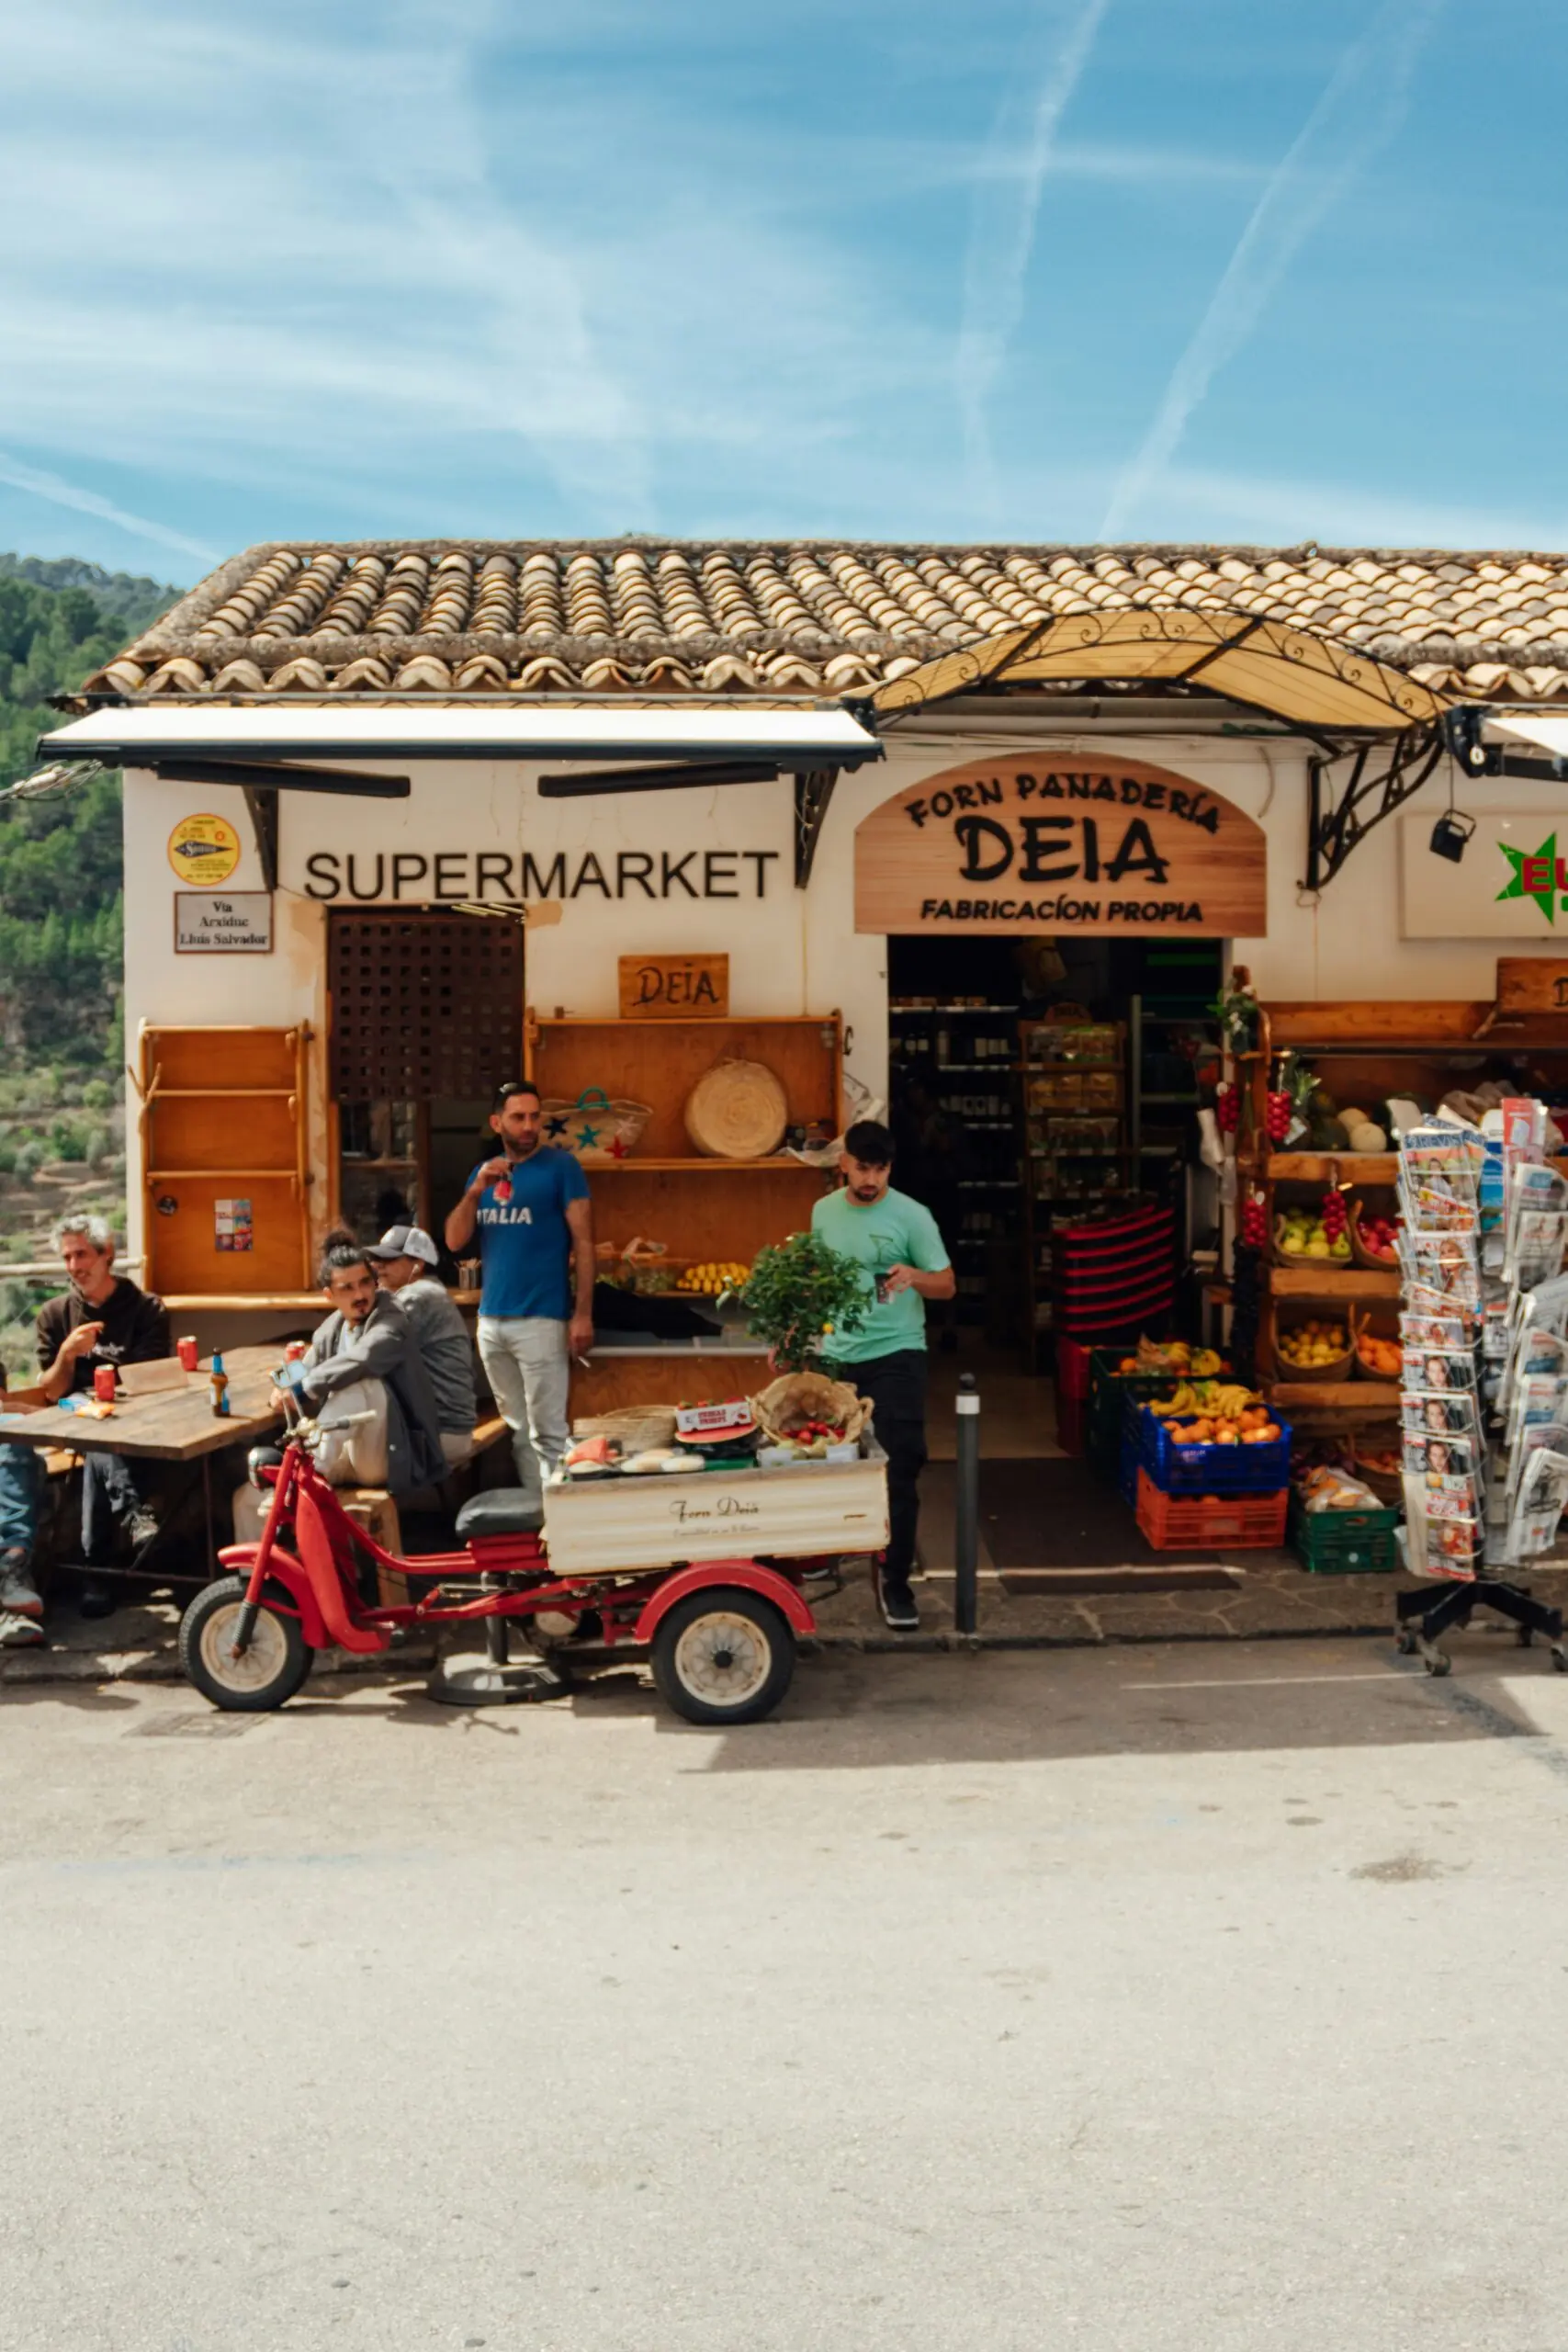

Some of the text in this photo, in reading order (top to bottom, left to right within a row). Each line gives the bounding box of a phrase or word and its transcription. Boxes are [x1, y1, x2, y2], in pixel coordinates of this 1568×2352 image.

[905, 773, 1221, 834] FORN PANADERÍA
[953, 814, 1170, 884] DEIA
[304, 852, 779, 899] SUPERMARKET
[199, 915, 249, 927] Arxiduc
[920, 894, 1204, 922] FABRICACÍON PROPIA
[213, 933, 268, 944] Salvador
[476, 1206, 532, 1225] ITALIA
